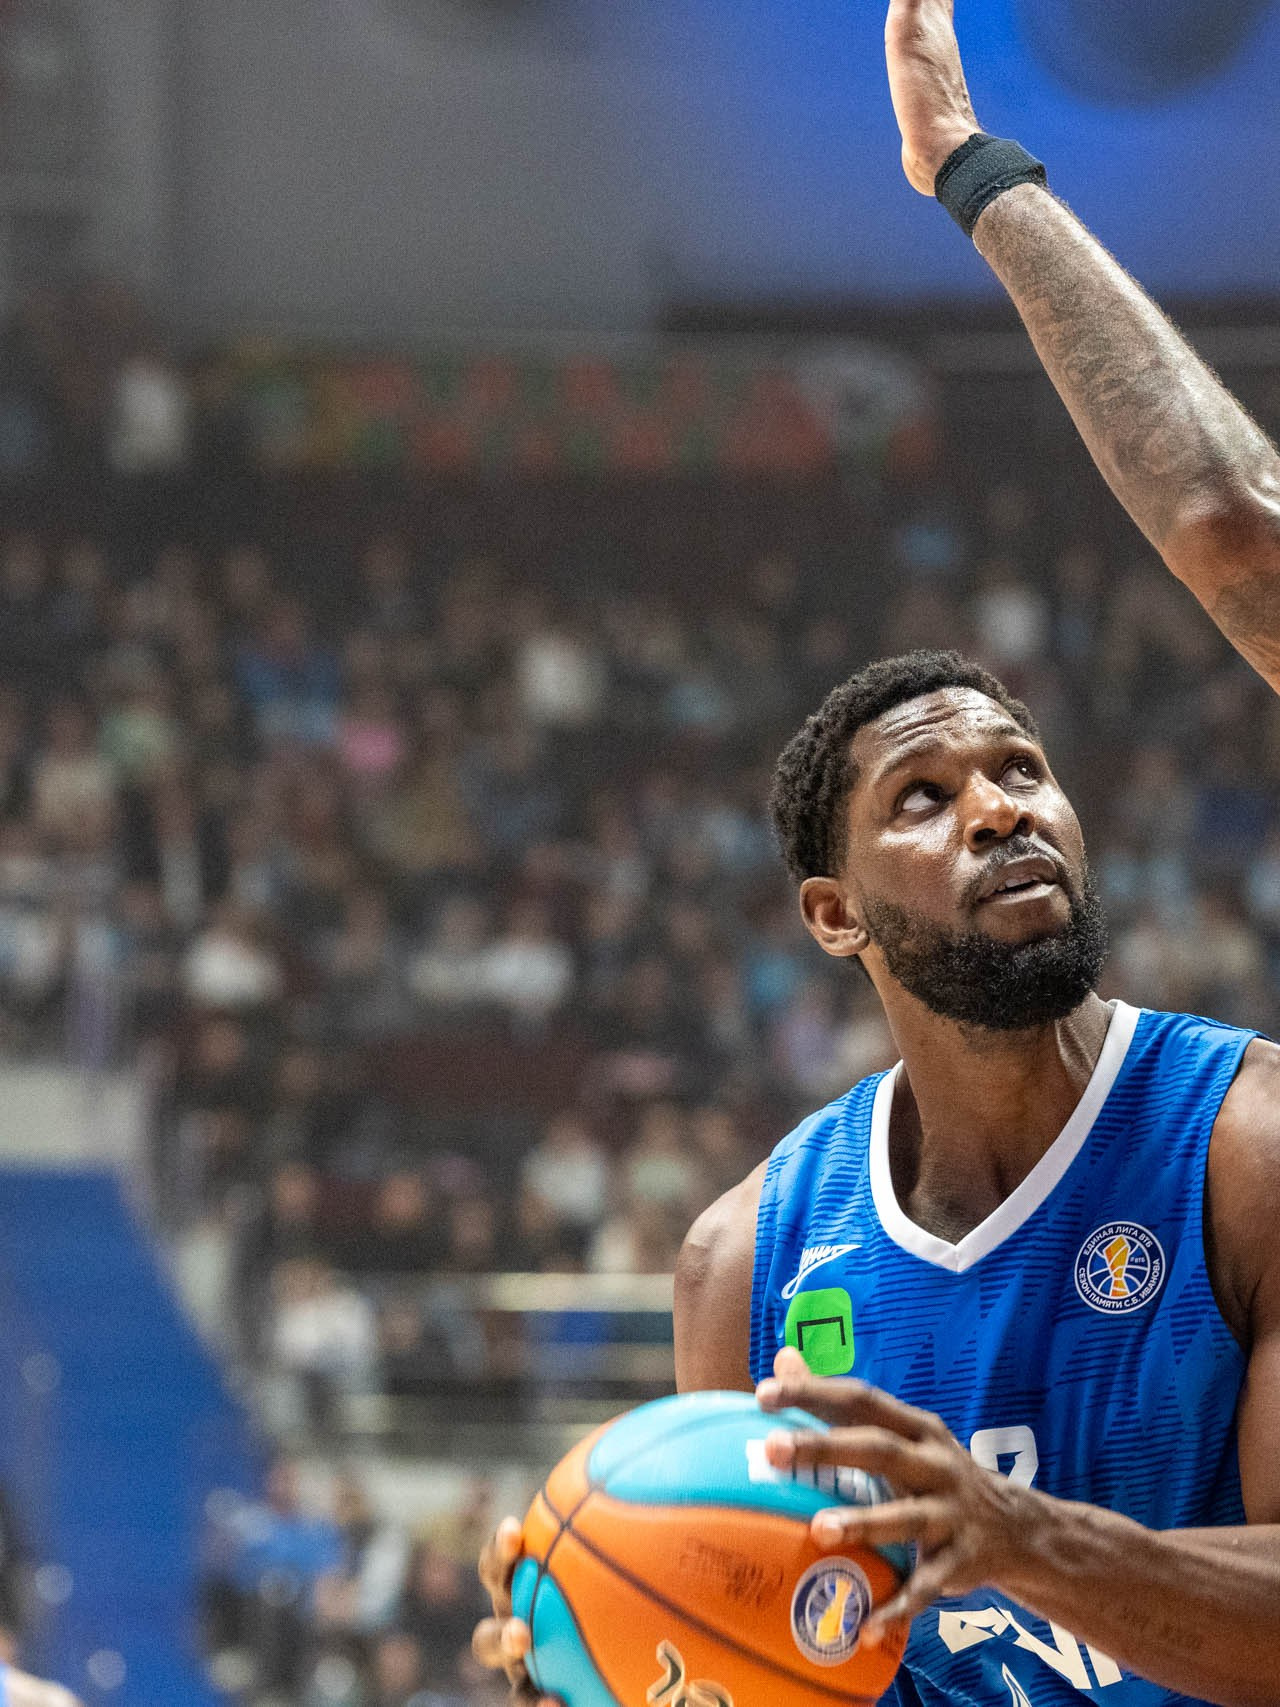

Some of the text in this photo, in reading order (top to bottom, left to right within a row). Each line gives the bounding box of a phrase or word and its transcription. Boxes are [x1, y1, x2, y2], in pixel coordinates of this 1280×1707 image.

[1083, 1226, 1153, 1256] ЕДИНАЯ ЛИГА ВТБ
[1078, 1258, 1160, 1309] СЕЗОН ПАМЯТИ С.Б. ИВАНОВА
